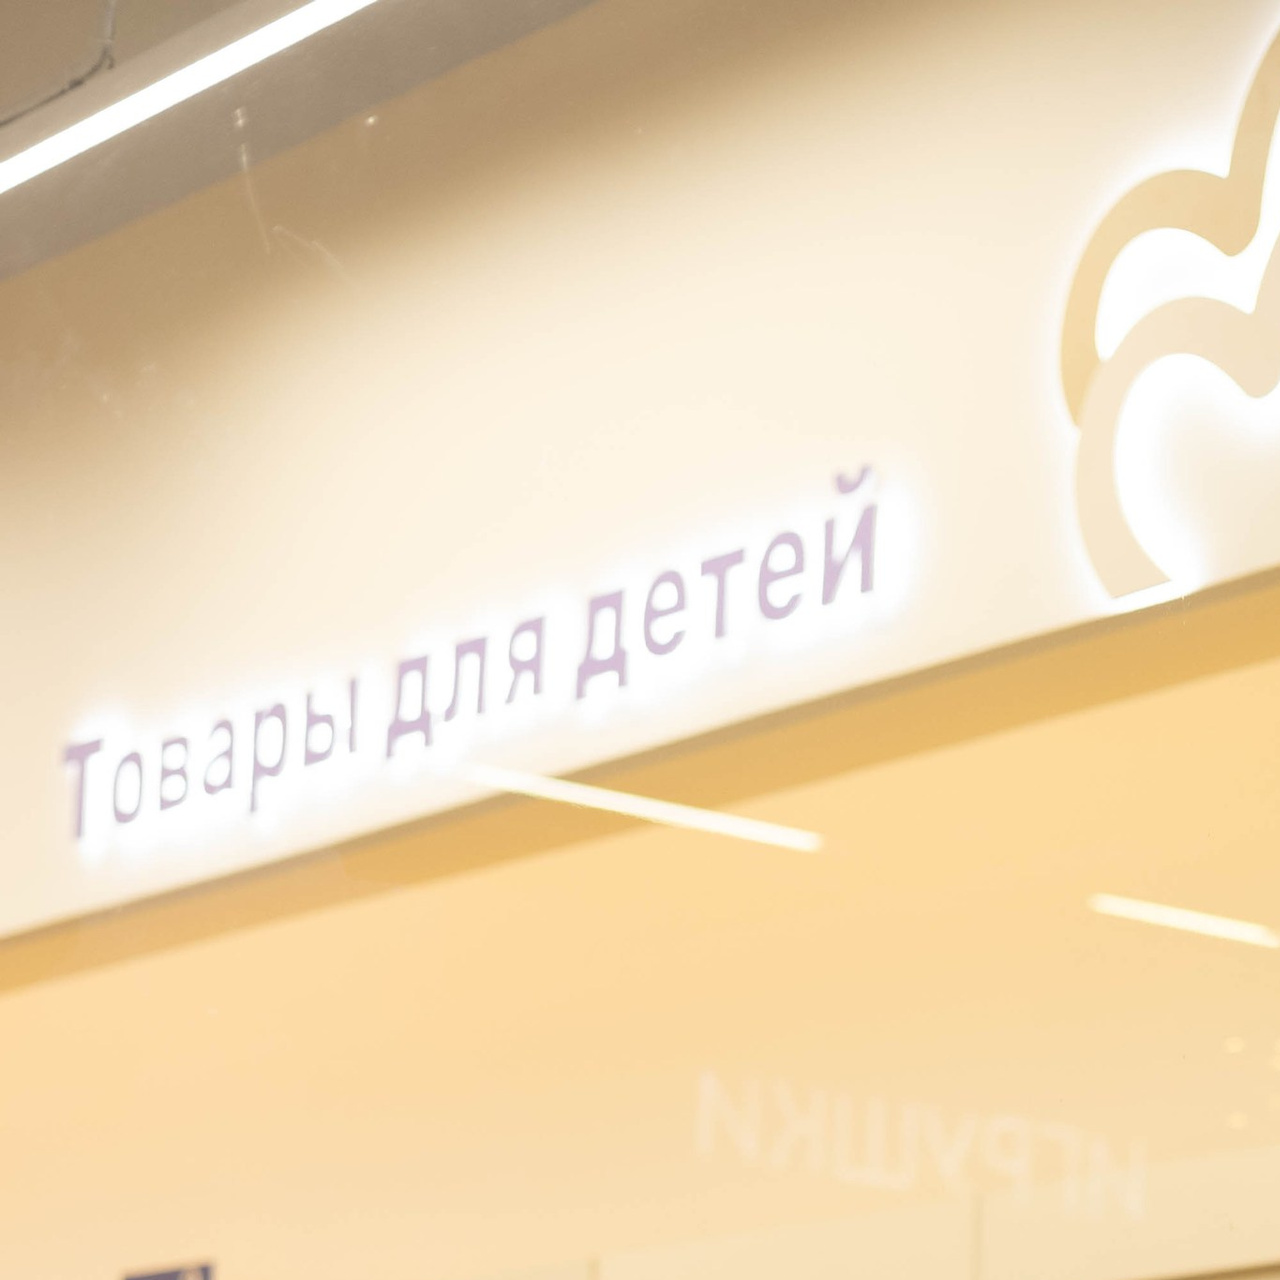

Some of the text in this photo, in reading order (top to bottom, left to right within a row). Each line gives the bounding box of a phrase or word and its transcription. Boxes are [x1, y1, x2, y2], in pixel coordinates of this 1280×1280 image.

[64, 466, 879, 839] Товары для детей
